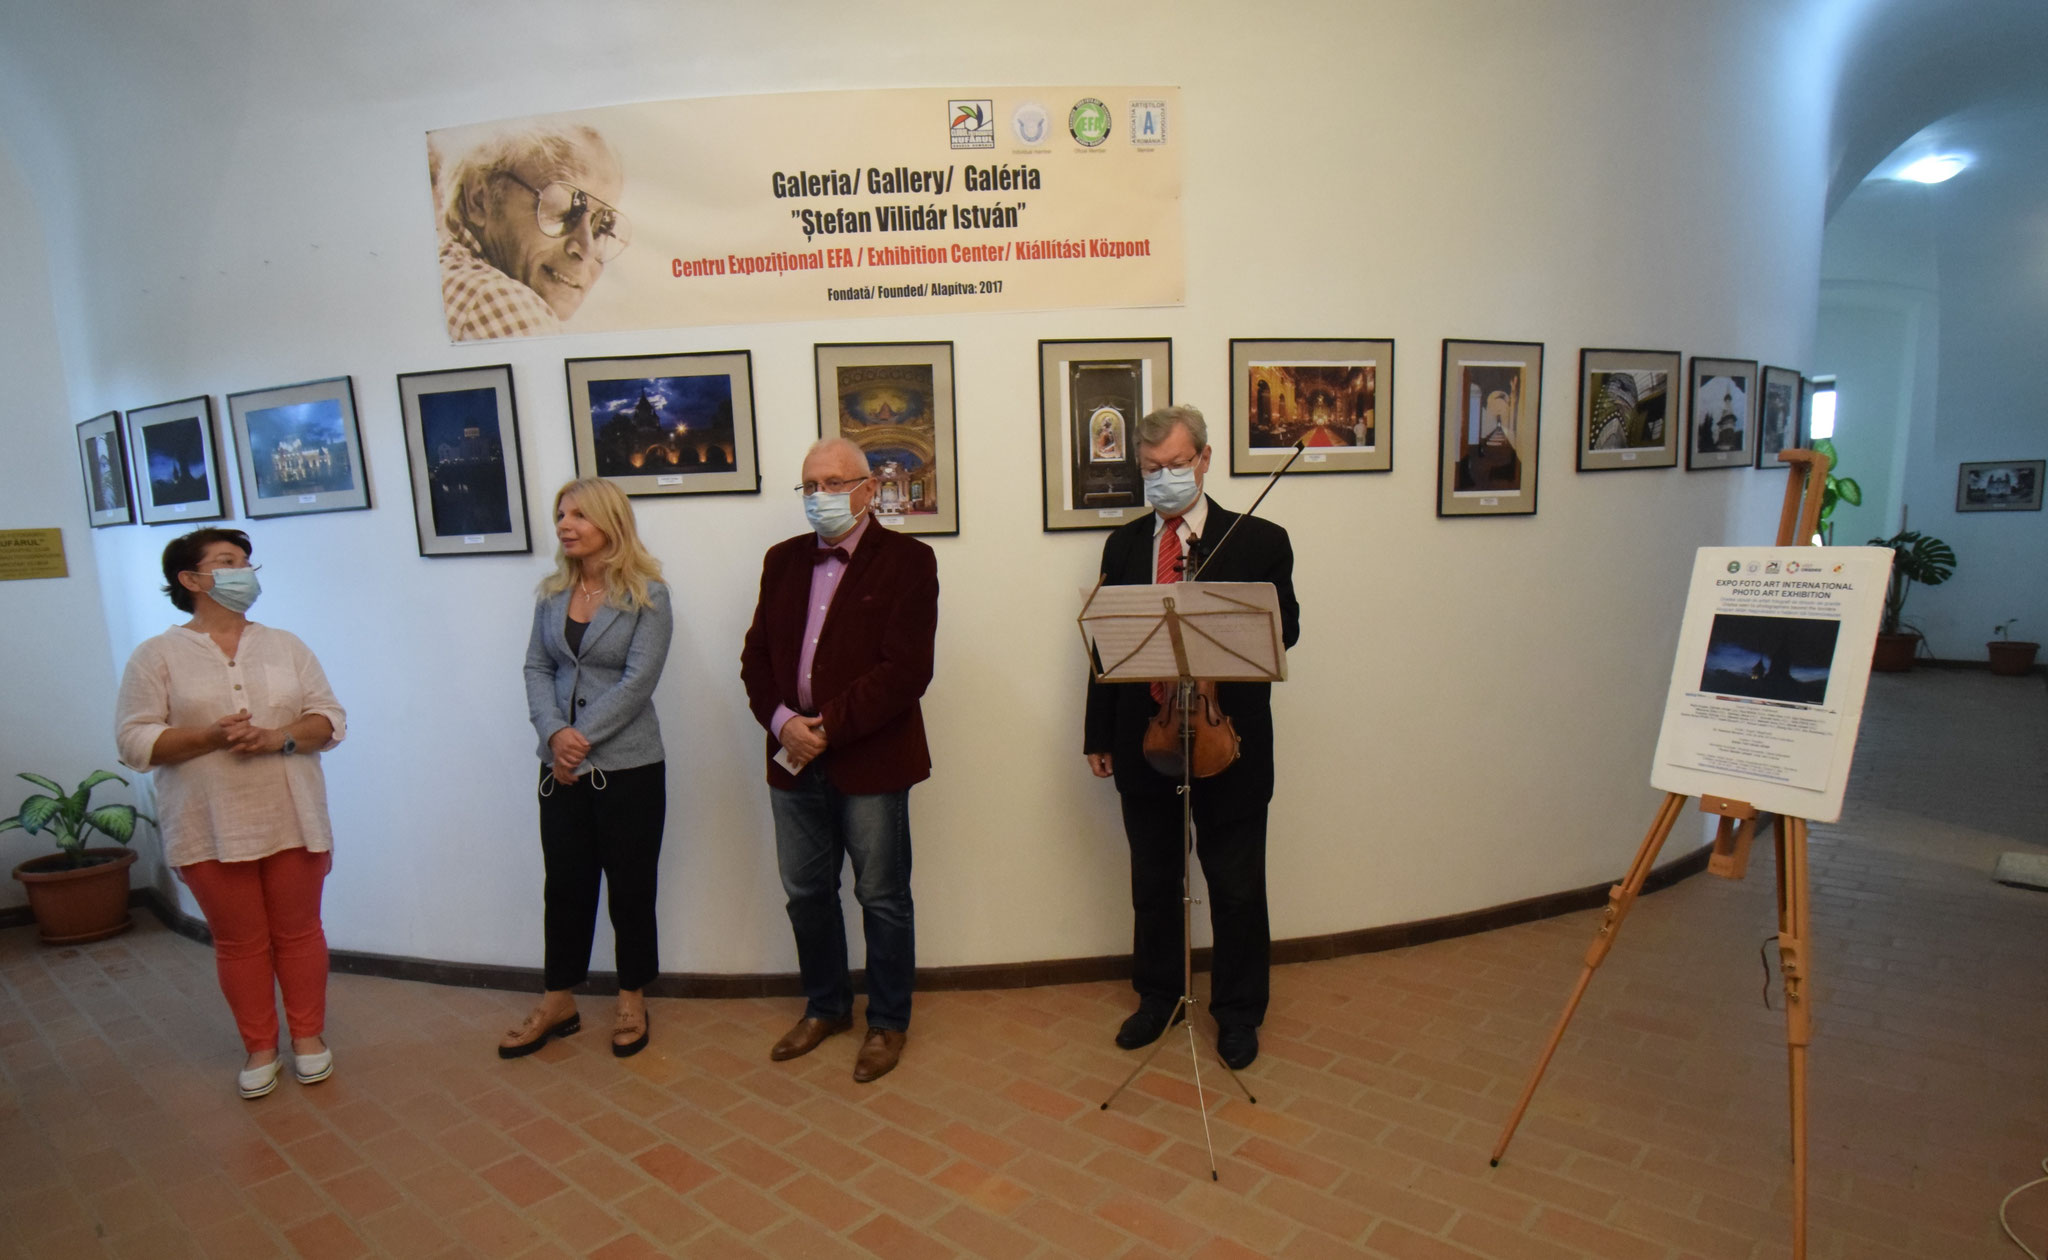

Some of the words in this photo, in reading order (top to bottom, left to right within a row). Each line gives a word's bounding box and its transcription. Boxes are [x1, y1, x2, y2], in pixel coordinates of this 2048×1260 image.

[772, 168, 861, 199] Galeria/
[867, 165, 954, 195] Gallery/
[964, 164, 1041, 192] Galéria
[875, 204, 947, 232] Vilidár
[672, 258, 726, 278] Centru
[728, 249, 824, 277] Expozițional
[826, 247, 854, 268] EFA
[867, 245, 948, 267] Exhibition
[951, 241, 1011, 263] Center/
[1015, 239, 1086, 260] Kiállítási
[1089, 238, 1151, 259] Központ
[827, 285, 875, 301] Fondată/
[878, 283, 928, 299] Founded/
[931, 281, 977, 297] Alapítva:
[979, 280, 1003, 294] 2017
[1716, 579, 1738, 587] EXPO
[1739, 580, 1761, 588] FOTO
[1763, 580, 1781, 588] ART
[1762, 589, 1779, 597] ART
[1781, 590, 1831, 598] EXHIBITION
